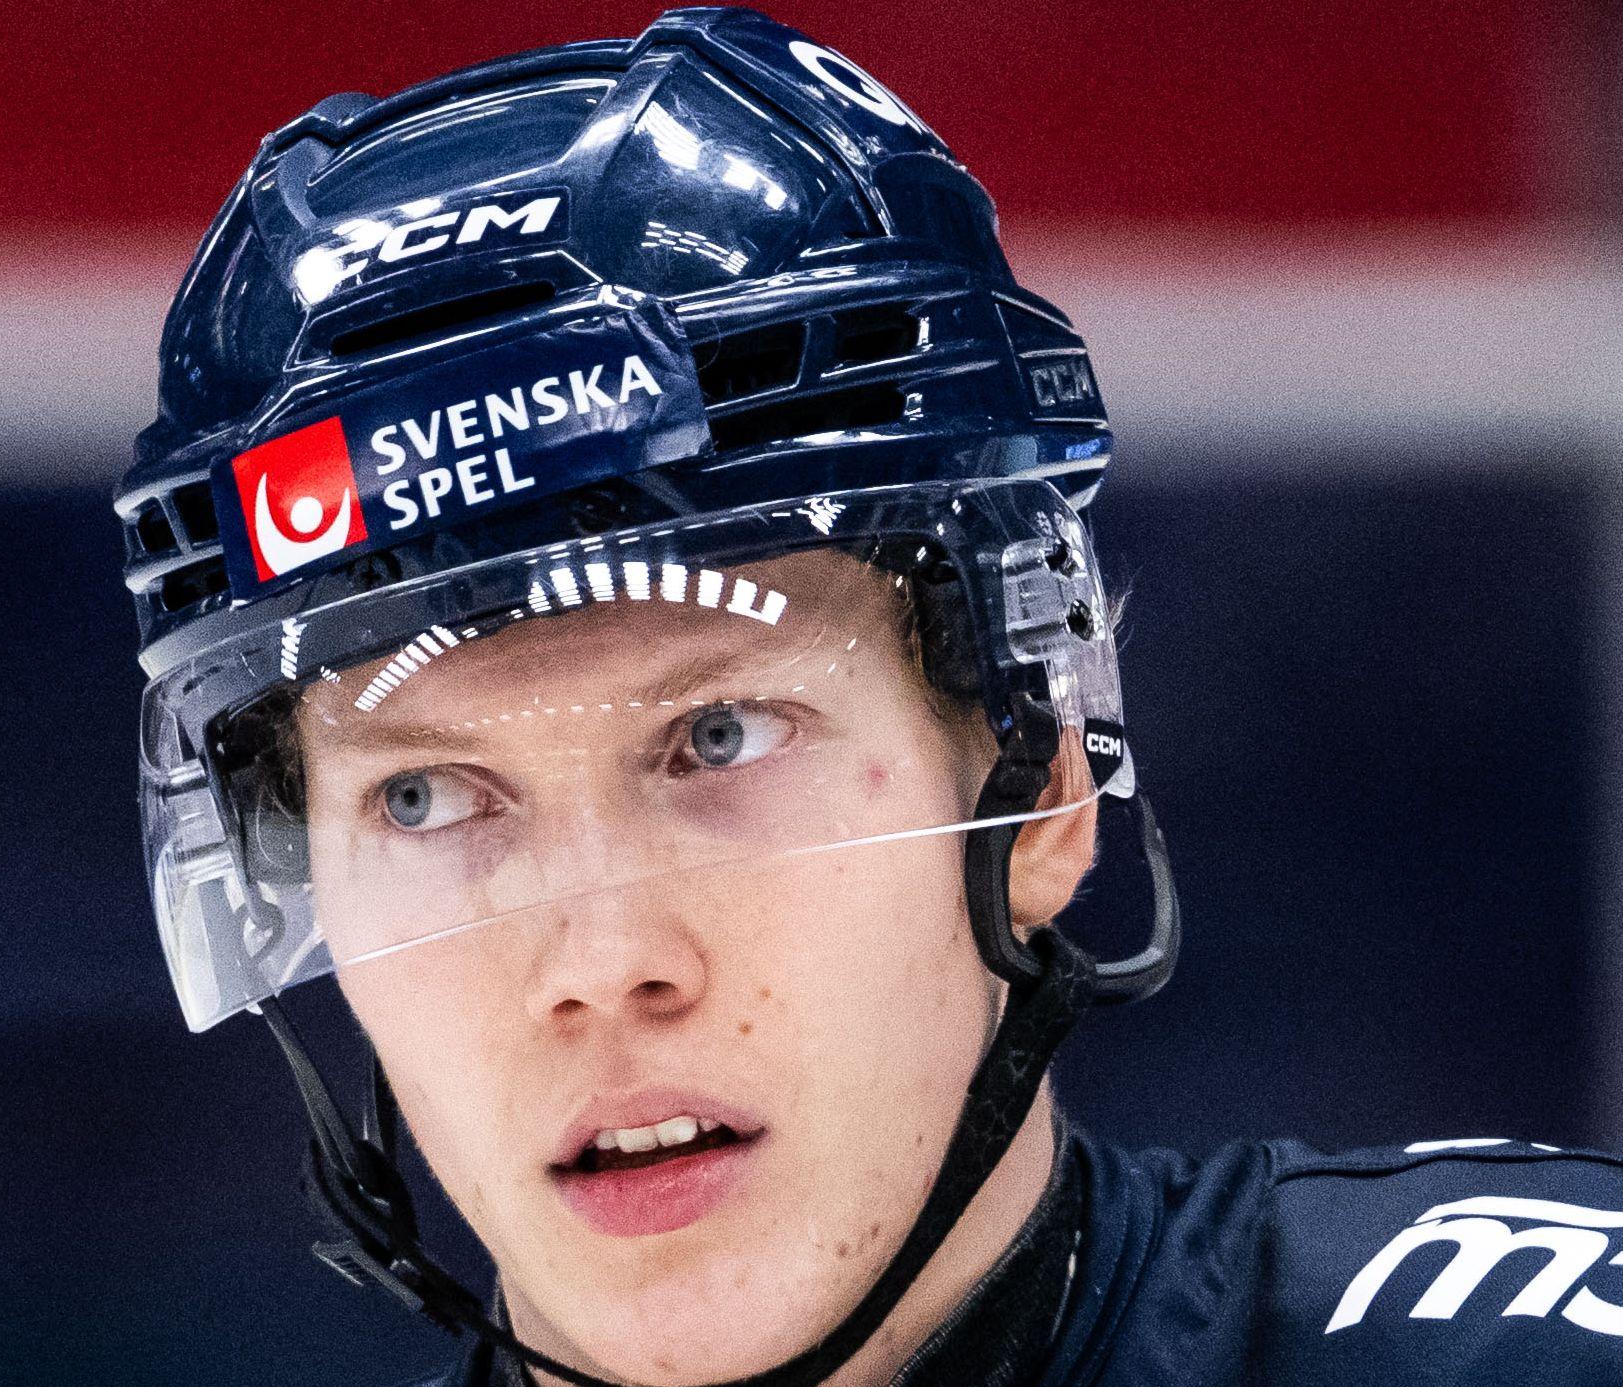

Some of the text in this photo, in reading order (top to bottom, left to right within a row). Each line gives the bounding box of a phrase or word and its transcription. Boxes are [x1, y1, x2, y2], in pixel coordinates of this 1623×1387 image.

[370, 355, 663, 476] SVENSKA
[382, 448, 536, 531] SPEL
[1086, 733, 1121, 757] CCM
